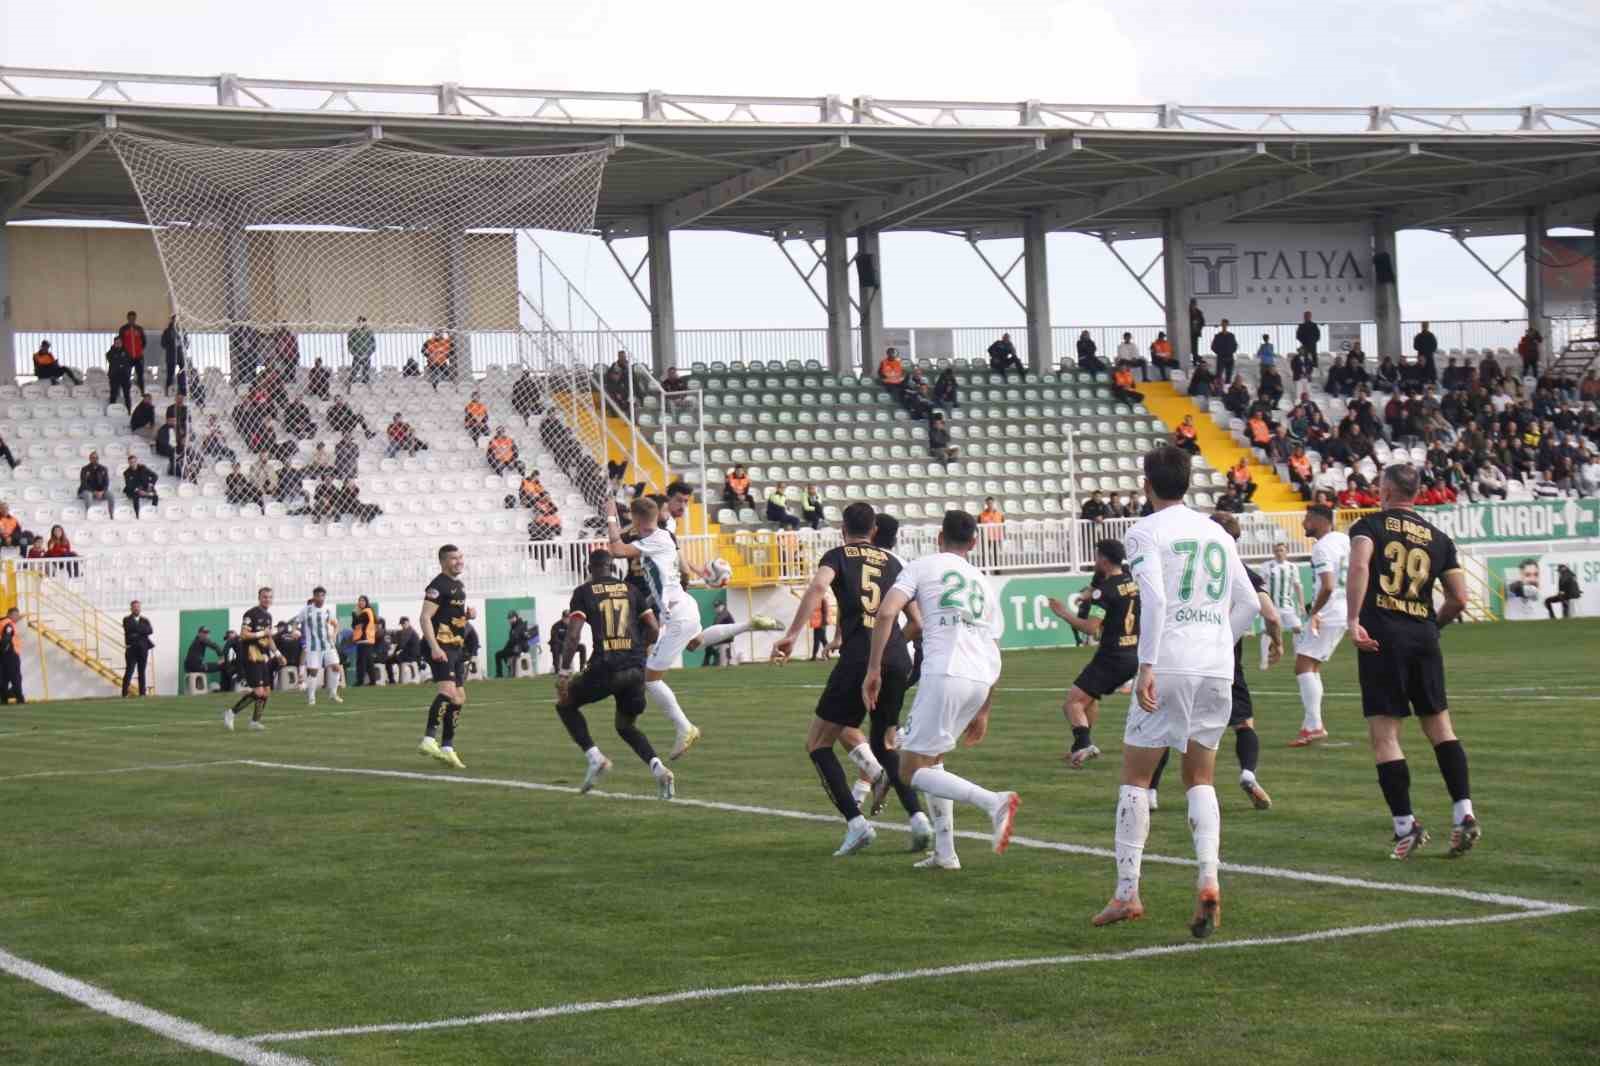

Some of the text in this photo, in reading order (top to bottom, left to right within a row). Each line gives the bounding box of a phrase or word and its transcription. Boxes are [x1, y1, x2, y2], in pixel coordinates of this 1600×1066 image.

[1244, 250, 1363, 280] TALYA
[860, 563, 882, 613] 5
[1171, 540, 1227, 601] 79
[1380, 541, 1431, 597] 39
[598, 599, 630, 638] 17
